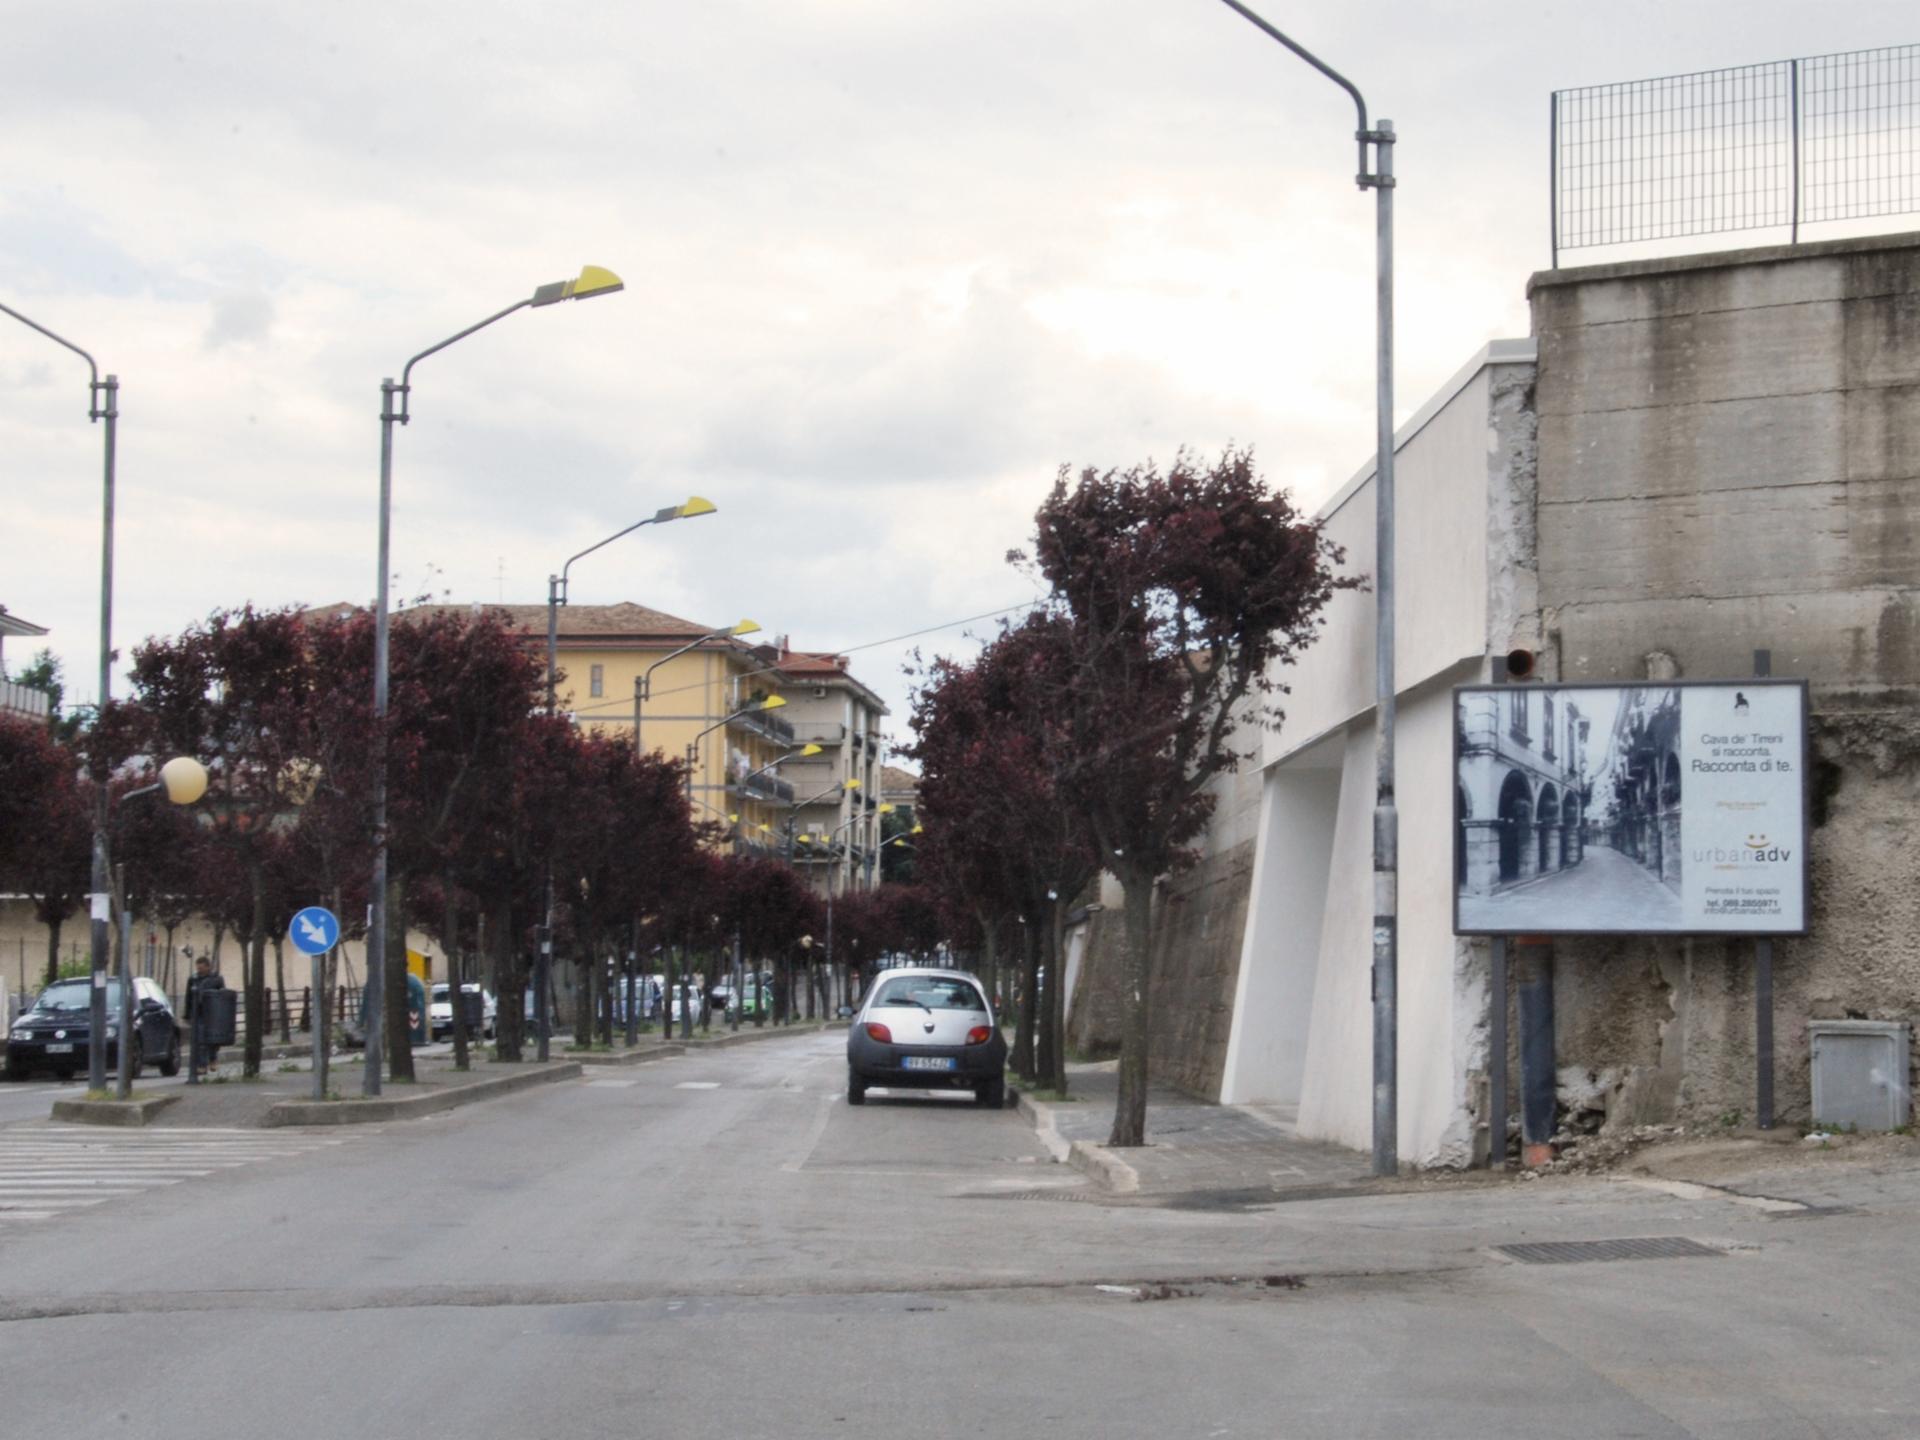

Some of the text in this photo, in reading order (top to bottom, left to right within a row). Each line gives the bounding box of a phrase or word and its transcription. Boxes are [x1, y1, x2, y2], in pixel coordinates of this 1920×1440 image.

[1701, 733, 1729, 744] Cava
[1751, 733, 1783, 744] Tirreni
[1712, 747, 1721, 756] si
[1692, 759, 1793, 772] Racconta di te.
[1693, 847, 1791, 862] urbanadv
